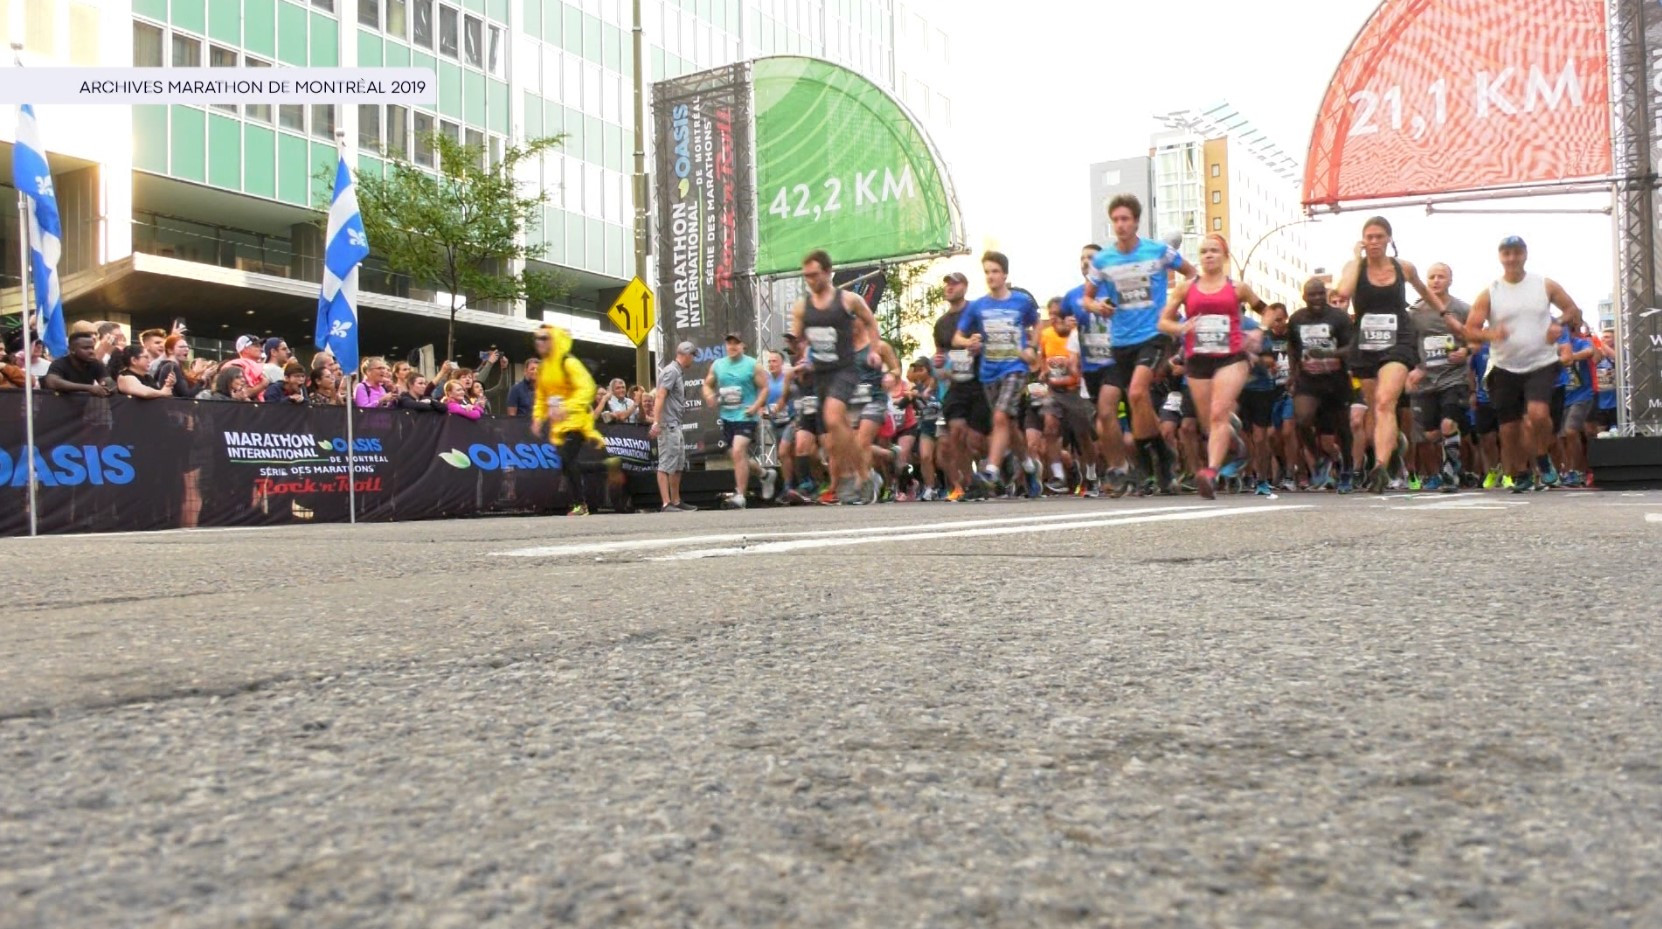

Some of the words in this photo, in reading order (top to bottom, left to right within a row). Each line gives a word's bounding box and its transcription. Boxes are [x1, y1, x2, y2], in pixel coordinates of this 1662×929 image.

[1348, 78, 1446, 140] 21,1
[1475, 57, 1582, 118] KM
[672, 104, 691, 178] OASIS
[692, 95, 702, 163] MONTRÉAL
[696, 169, 703, 185] DE
[704, 121, 715, 211] MARATHONS
[769, 178, 842, 222] 42,2
[855, 164, 915, 206] KM
[707, 214, 715, 241] DES
[672, 202, 690, 329] MARATHON
[687, 200, 701, 328] INTERNATIONAL
[705, 245, 715, 285] SÉRIE
[224, 431, 316, 448] MARATHON
[227, 446, 319, 460] INTERNATIONAL
[468, 443, 562, 471] OASIS
[290, 466, 311, 474] DES
